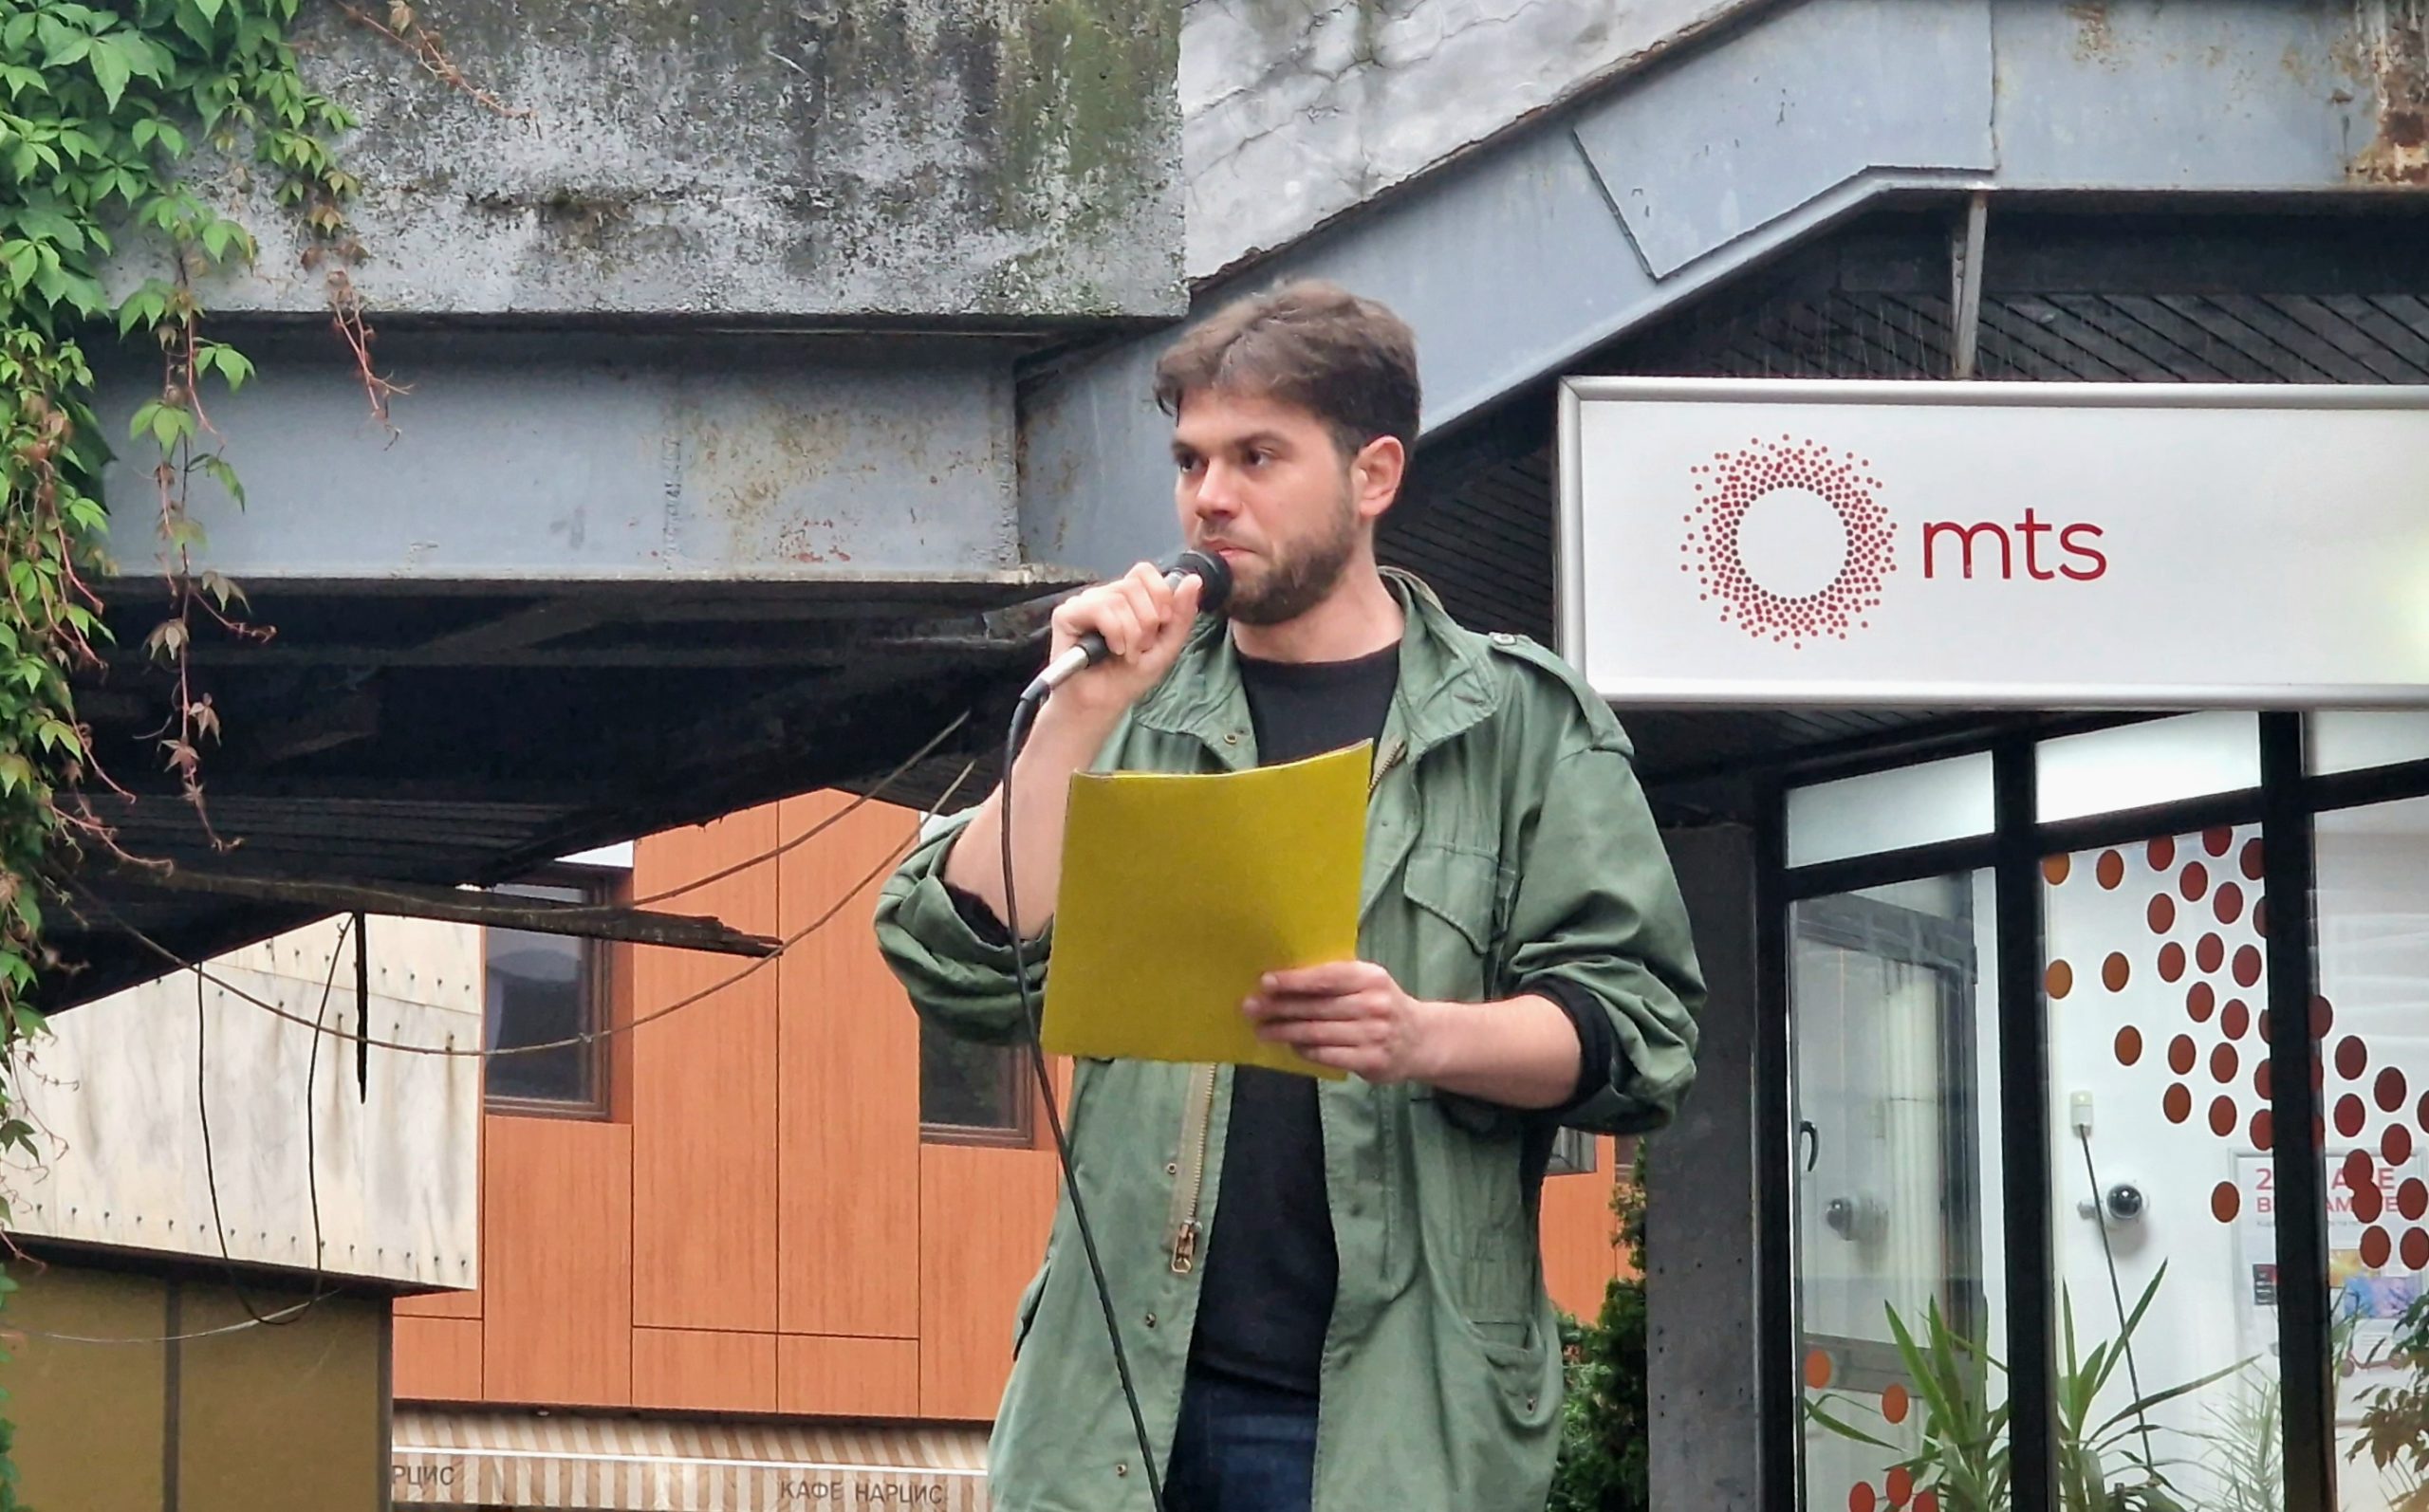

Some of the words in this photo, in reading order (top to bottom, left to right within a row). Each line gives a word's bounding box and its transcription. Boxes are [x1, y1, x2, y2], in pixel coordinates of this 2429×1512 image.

[1923, 507, 2106, 581] mts
[392, 1465, 454, 1488] РЦИС
[780, 1480, 844, 1501] КАФЕ
[855, 1482, 943, 1505] НАРЦИС
